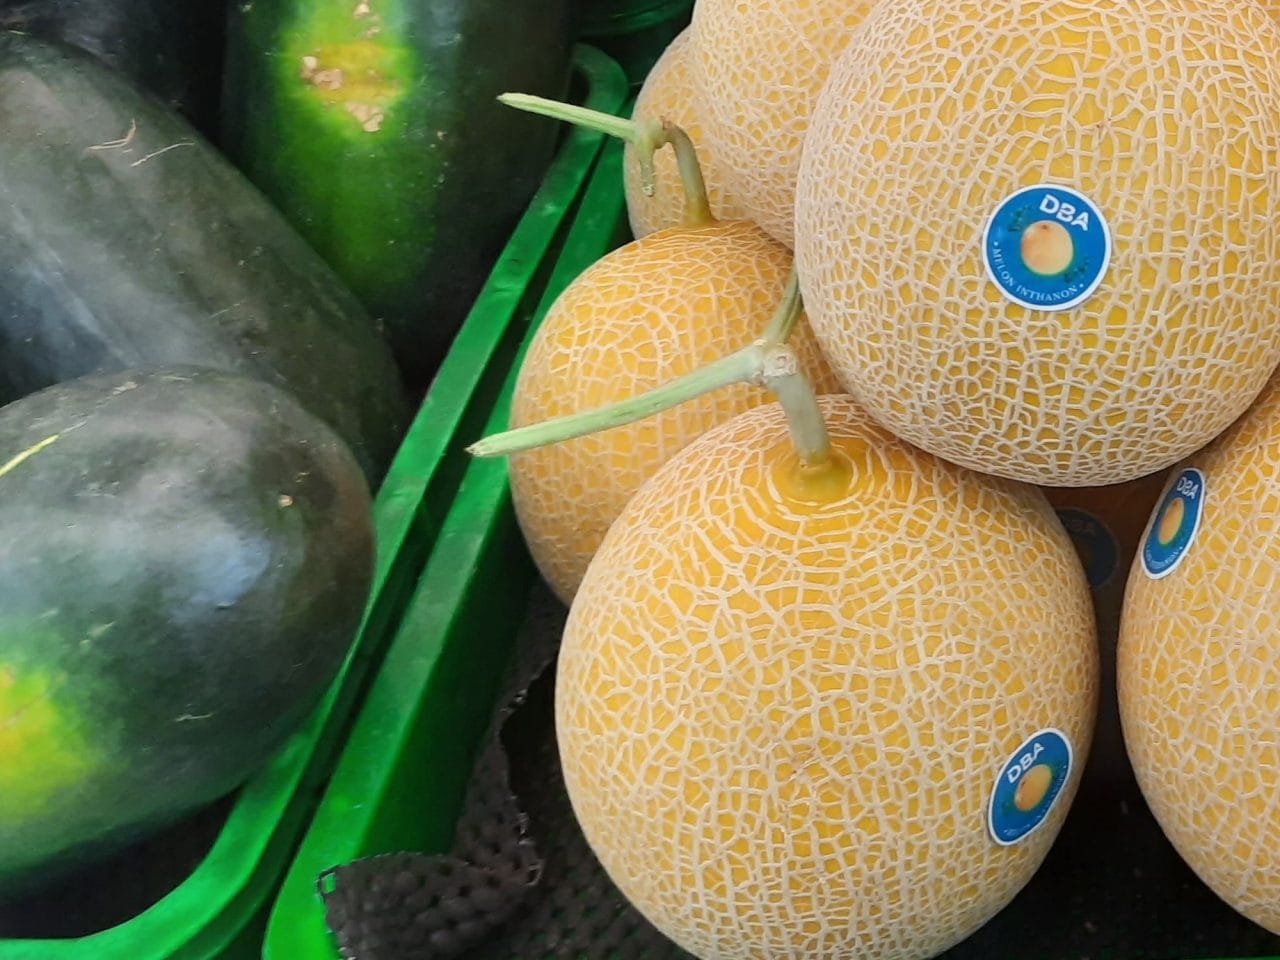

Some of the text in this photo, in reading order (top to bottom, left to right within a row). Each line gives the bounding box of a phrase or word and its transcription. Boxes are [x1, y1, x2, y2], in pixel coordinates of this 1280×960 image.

[1039, 193, 1089, 231] DBA
[992, 248, 1078, 301] MELON INTHANON
[1176, 476, 1199, 500] DBA
[1006, 742, 1045, 783] DBA
